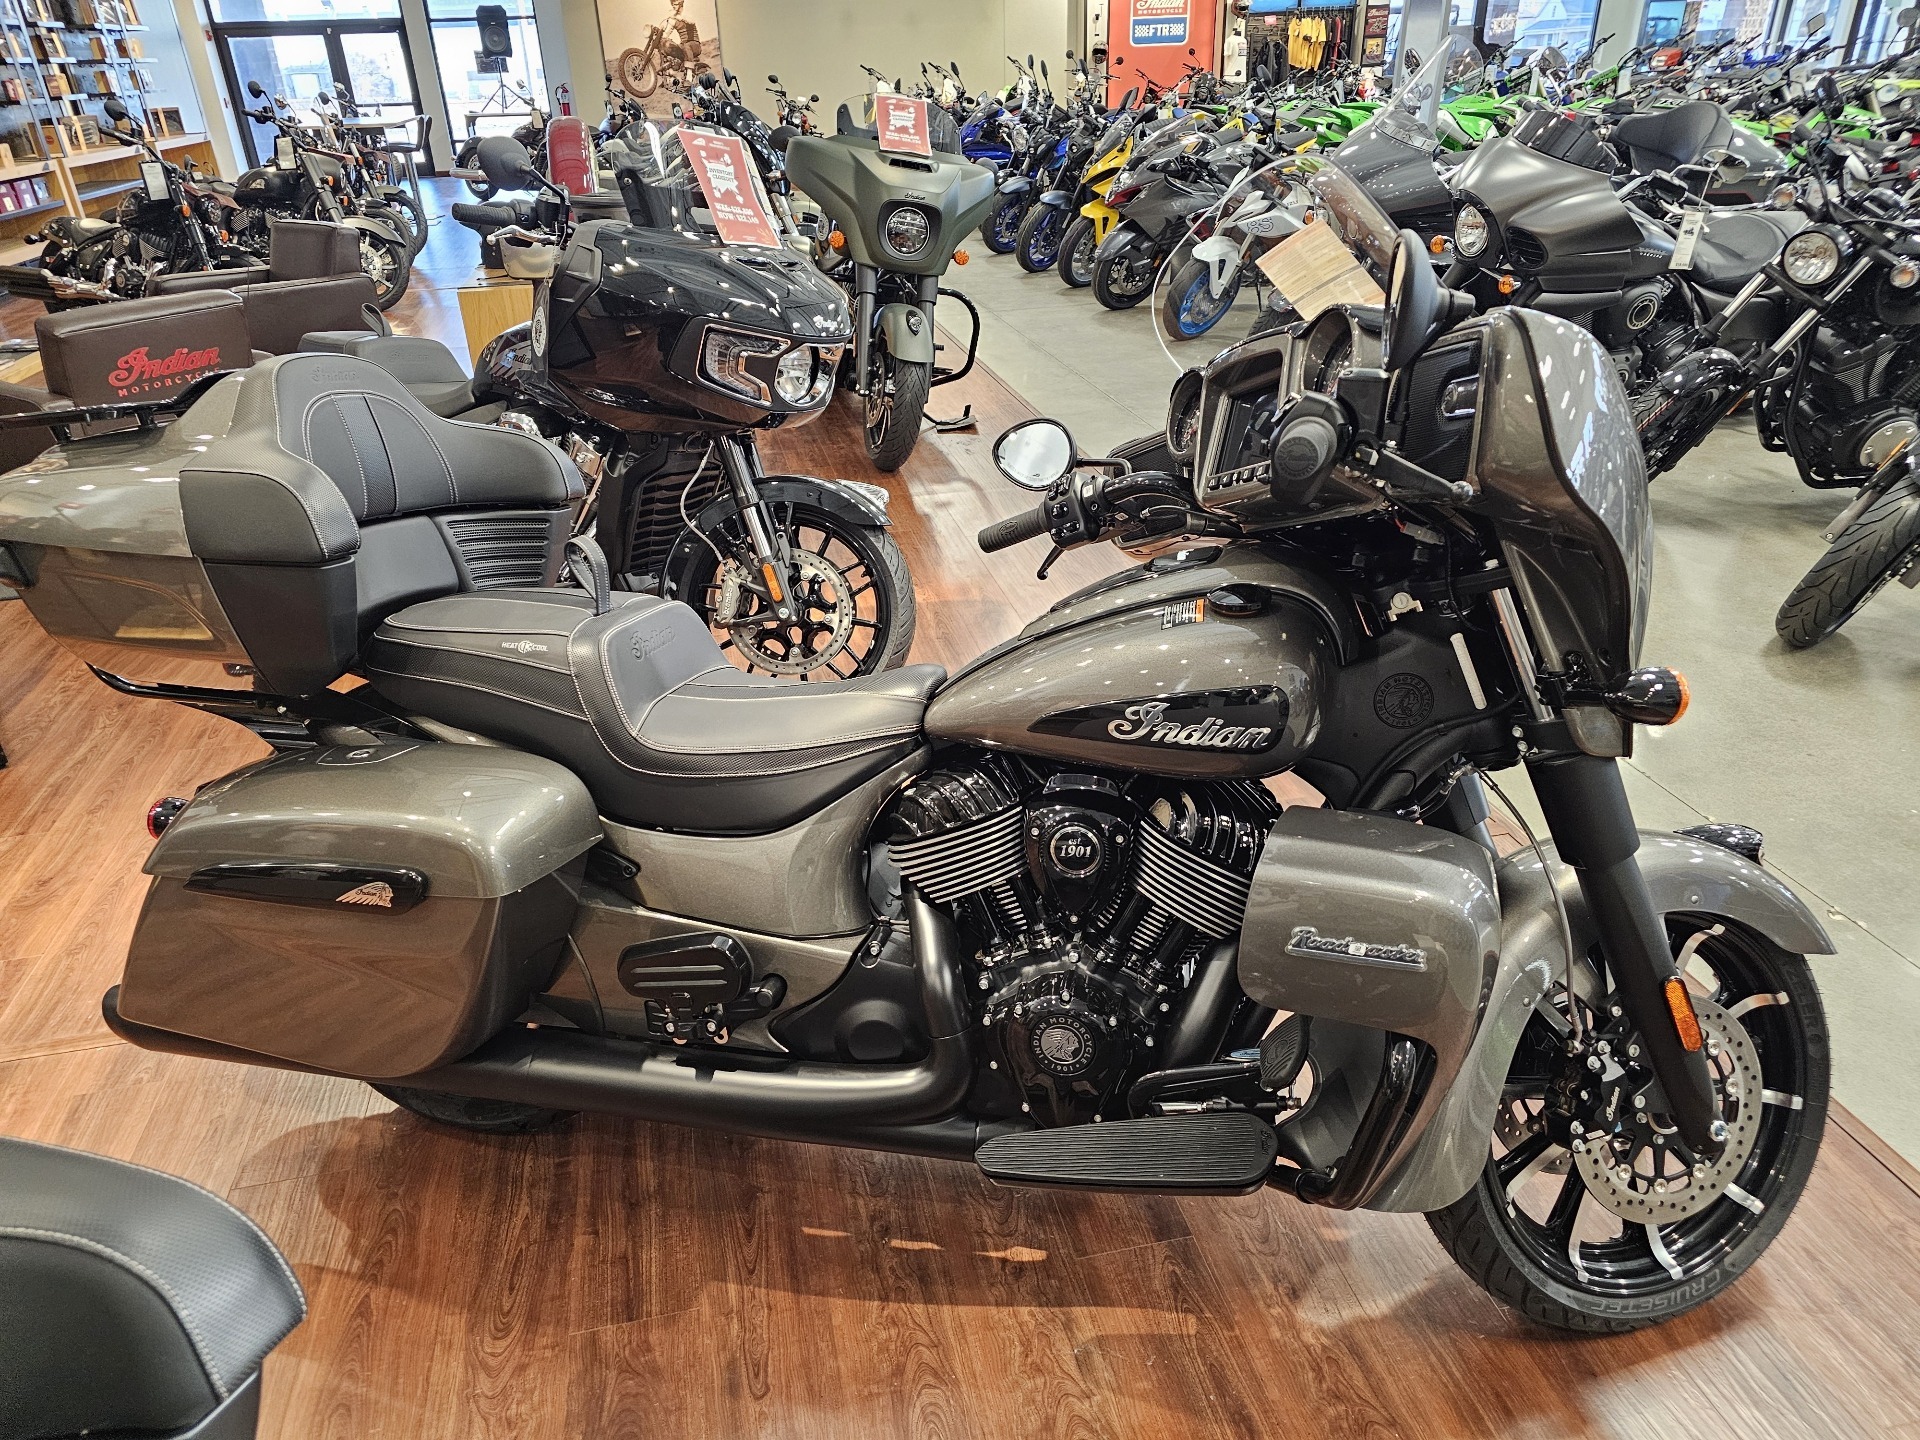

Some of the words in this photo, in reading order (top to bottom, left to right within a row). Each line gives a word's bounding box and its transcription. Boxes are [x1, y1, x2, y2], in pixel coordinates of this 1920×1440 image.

[1148, 24, 1171, 37] FTR
[108, 346, 221, 387] Indian
[501, 641, 519, 649] HEAT
[532, 644, 549, 652] COOL
[630, 627, 676, 661] Indian
[1107, 701, 1272, 749] Indian
[1059, 845, 1092, 858] 1901
[355, 888, 378, 898] Indian
[1285, 926, 1427, 968] Roadaster
[1033, 1022, 1047, 1059] INDIAN
[1049, 1017, 1093, 1065] MOTORCYCLE
[1051, 1063, 1074, 1072] 1901
[1606, 1086, 1621, 1122] Indian
[1590, 1267, 1721, 1314] CRUISETEC
